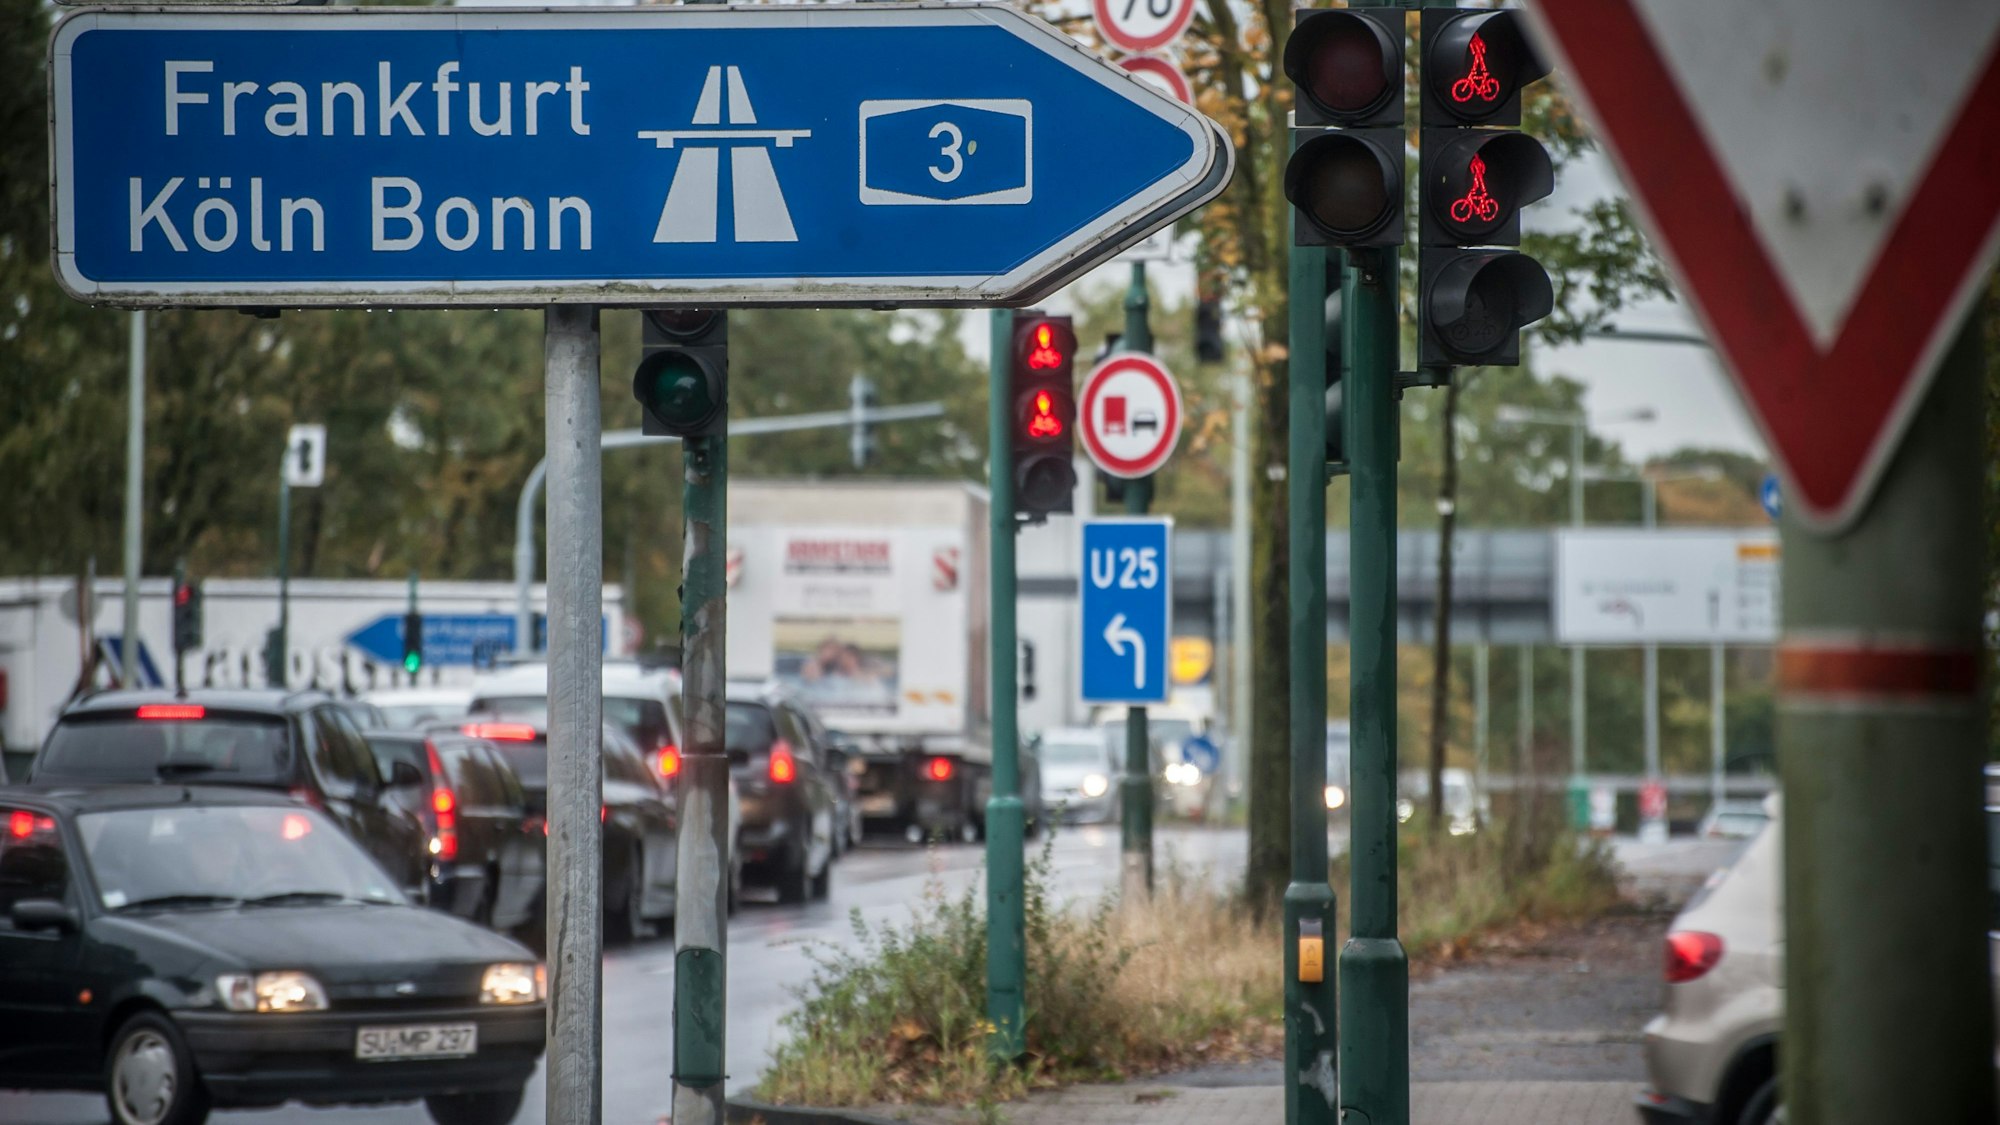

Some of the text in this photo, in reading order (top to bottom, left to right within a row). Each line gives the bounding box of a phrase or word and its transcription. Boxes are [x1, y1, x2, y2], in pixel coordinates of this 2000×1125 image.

[164, 60, 591, 136] Frankfurt
[928, 121, 964, 183] 3
[129, 176, 593, 253] Köln Bonn
[1091, 547, 1159, 590] U 25
